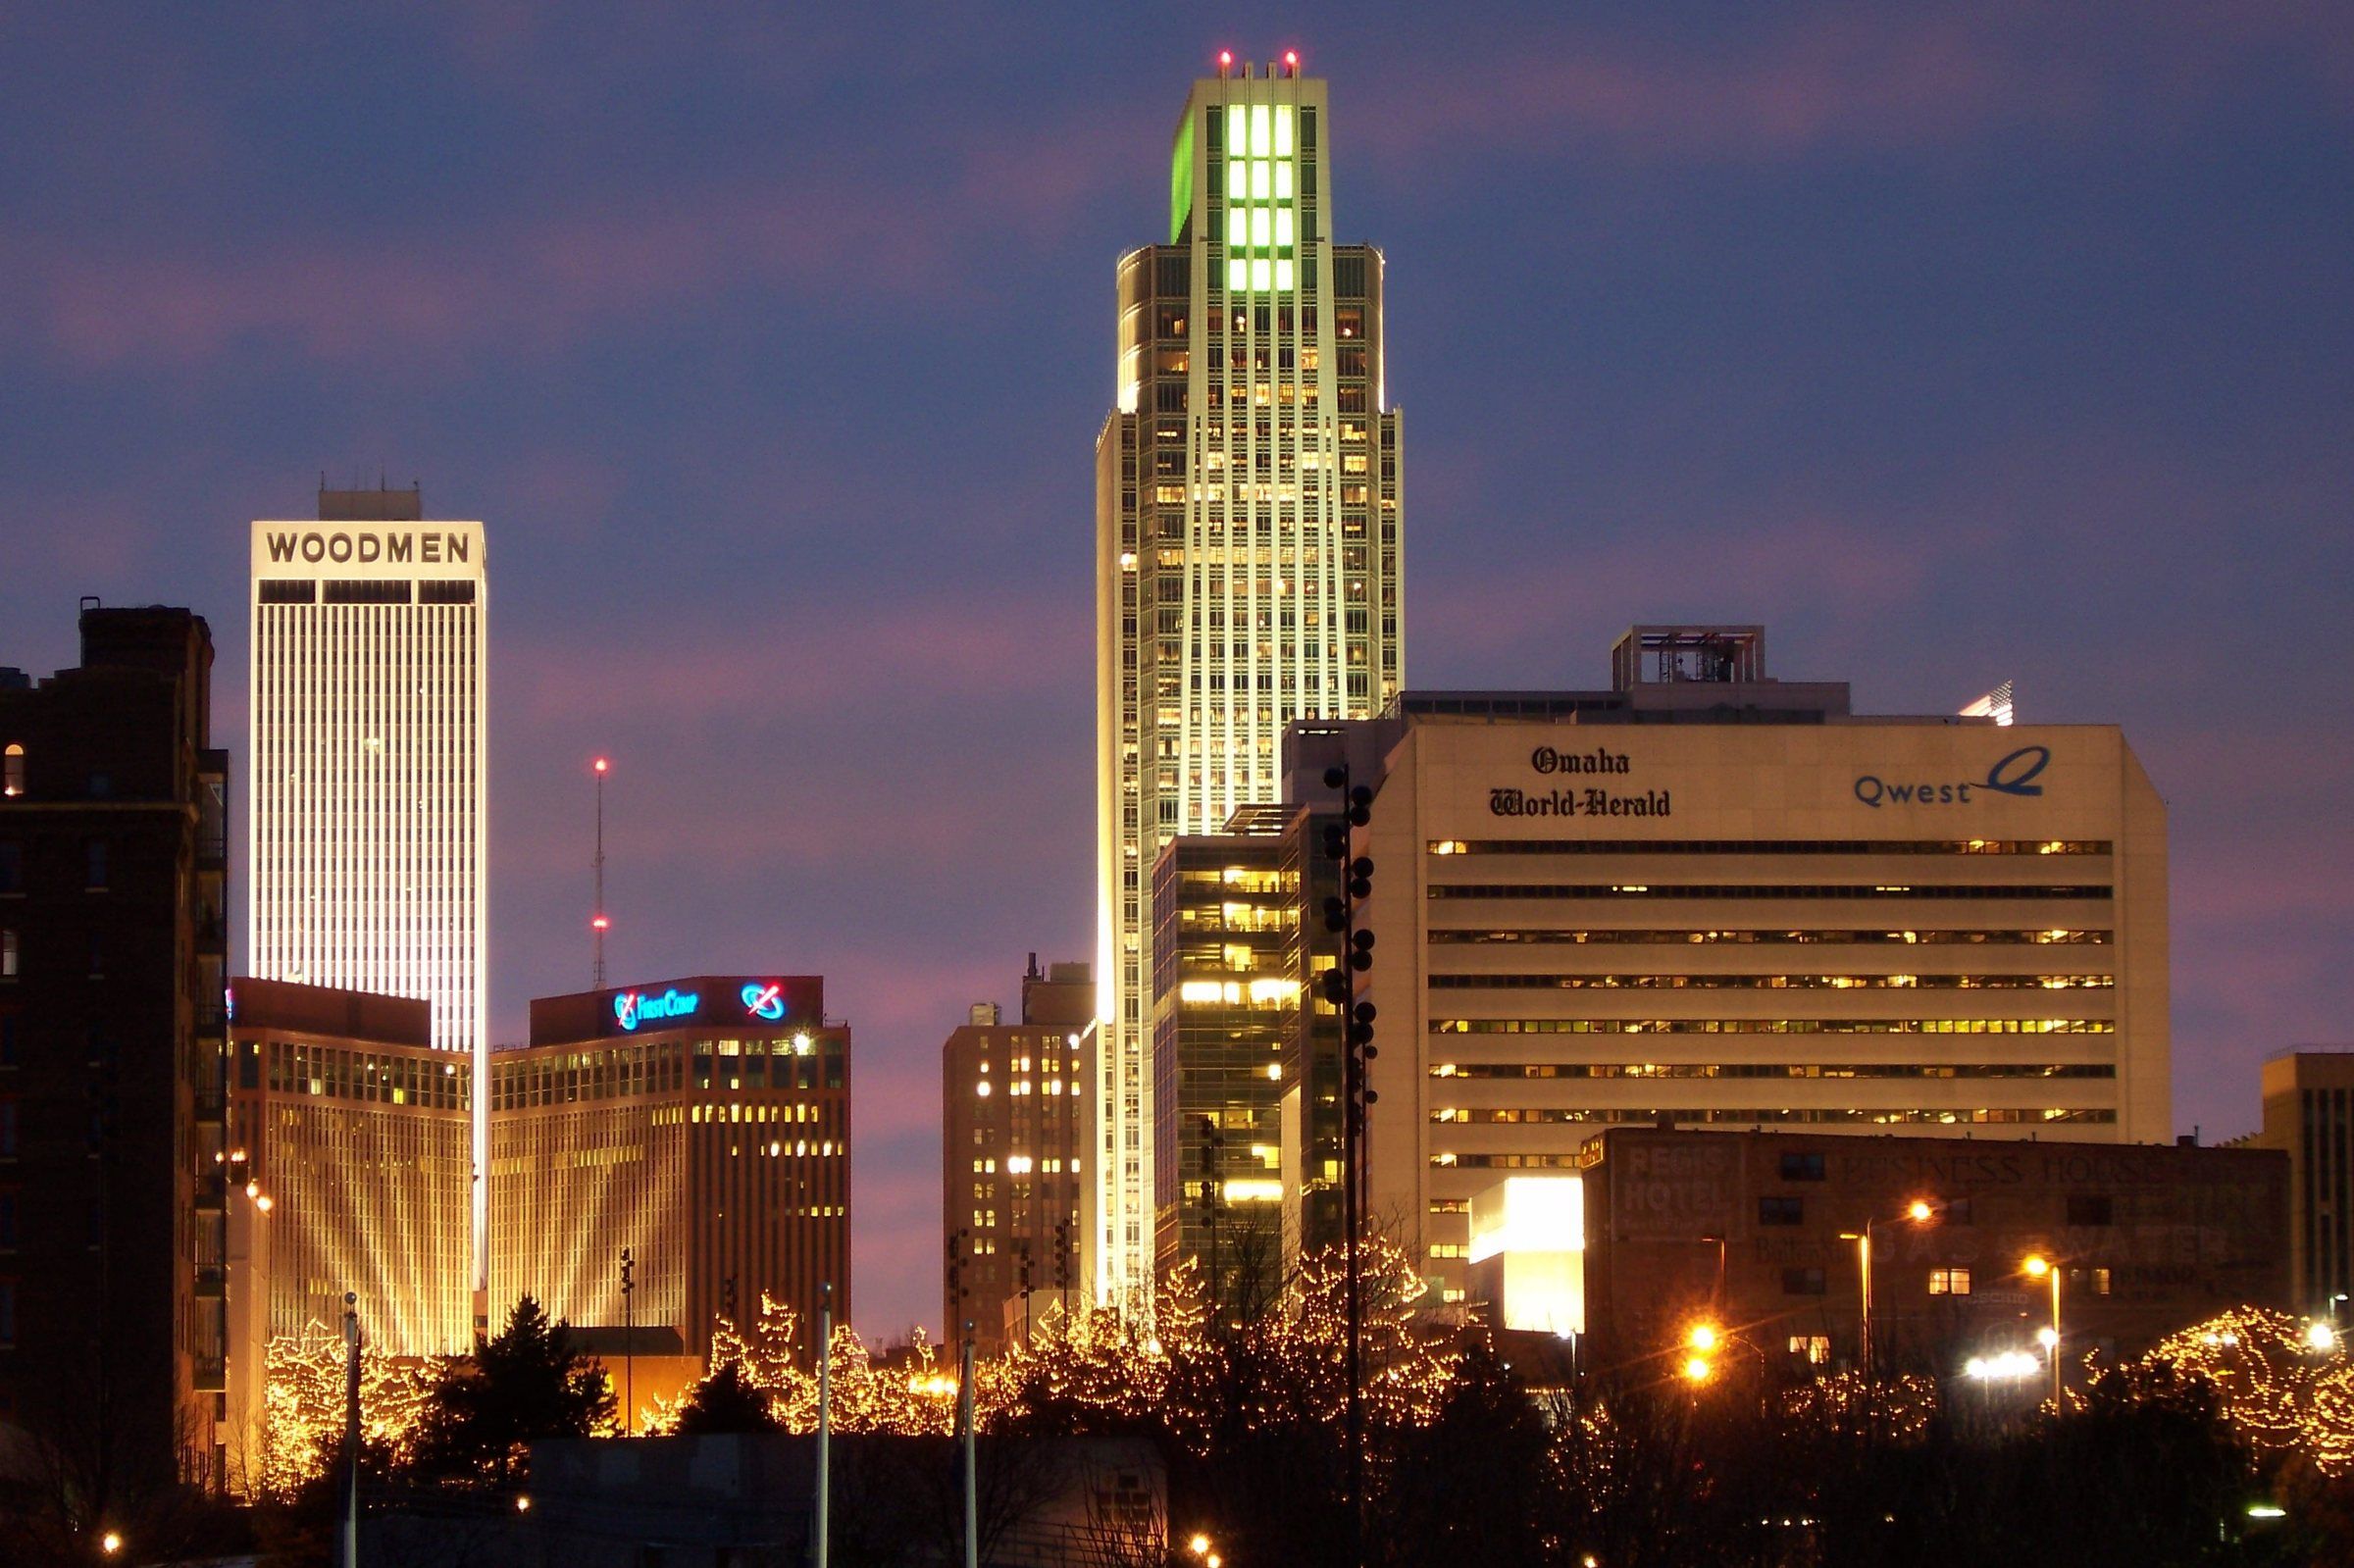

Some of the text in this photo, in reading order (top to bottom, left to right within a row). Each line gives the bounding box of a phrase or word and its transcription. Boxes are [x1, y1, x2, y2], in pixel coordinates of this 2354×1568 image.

[267, 532, 468, 563] WOODMEN
[1532, 746, 1630, 775] Omaha
[1490, 788, 1671, 817] World-Herald
[1855, 776, 1970, 807] Qwest
[1843, 1154, 2166, 1185] BUSINESS HOUSE
[1624, 1180, 1730, 1211] HOTEL
[2052, 1226, 2244, 1264] WATER
